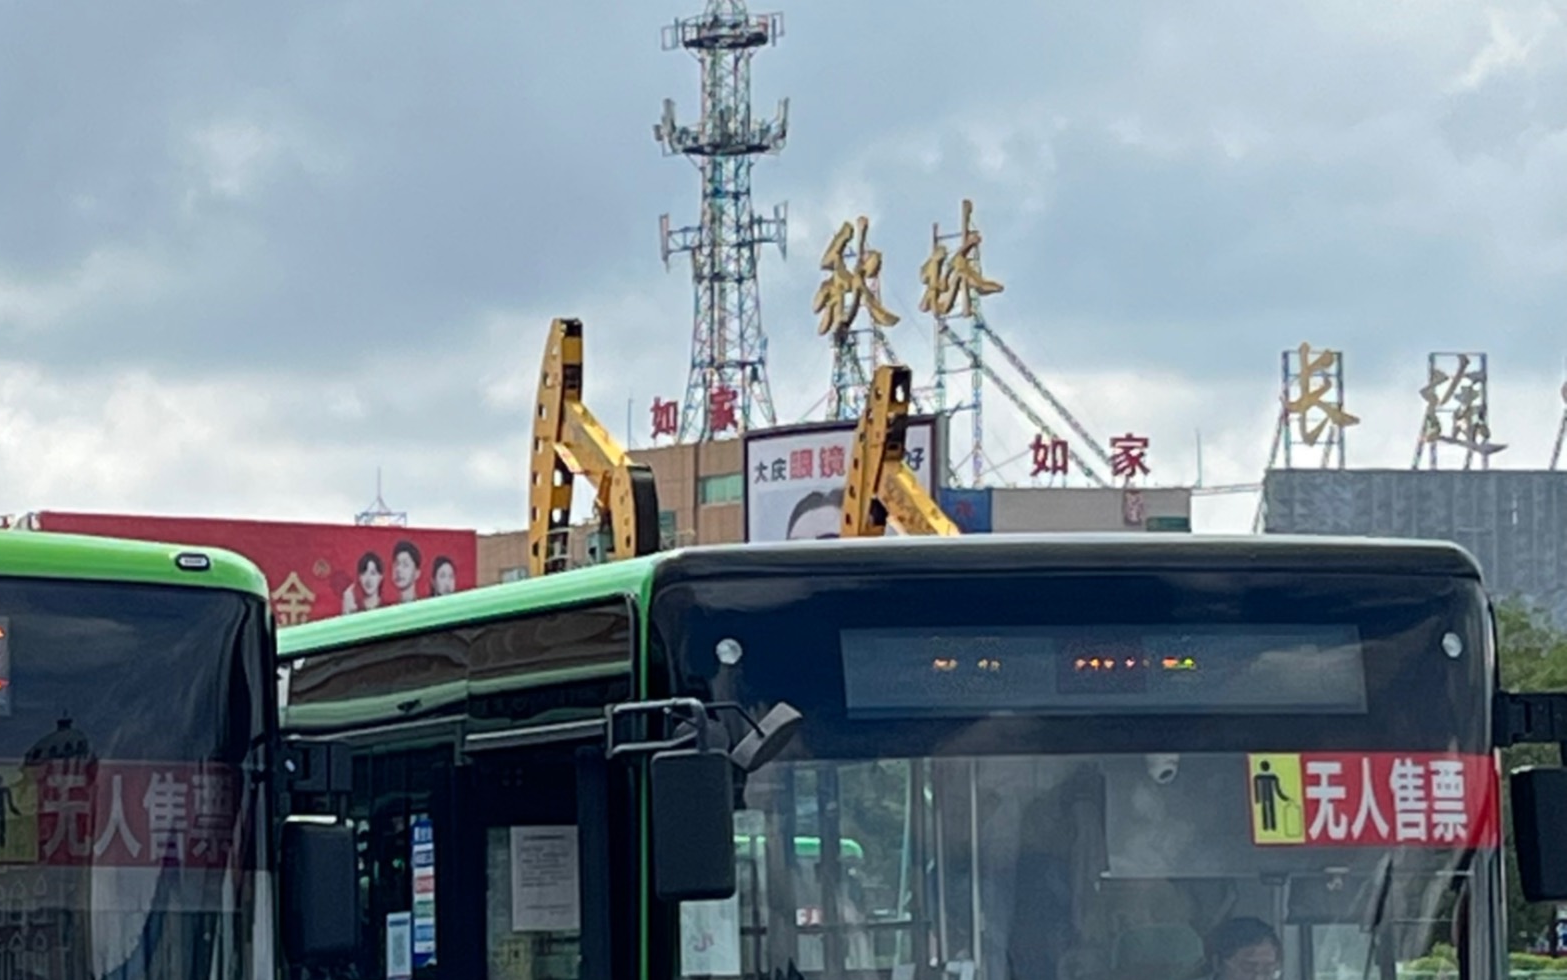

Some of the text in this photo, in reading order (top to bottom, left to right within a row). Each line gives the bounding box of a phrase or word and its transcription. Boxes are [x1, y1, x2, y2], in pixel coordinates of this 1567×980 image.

[813, 198, 1004, 335] 秋林
[651, 386, 738, 439] 如家
[1280, 341, 1567, 456] 长途
[1029, 432, 1151, 478] 如家
[42, 772, 232, 861] 无人售票
[1305, 757, 1468, 842] 无人售票
